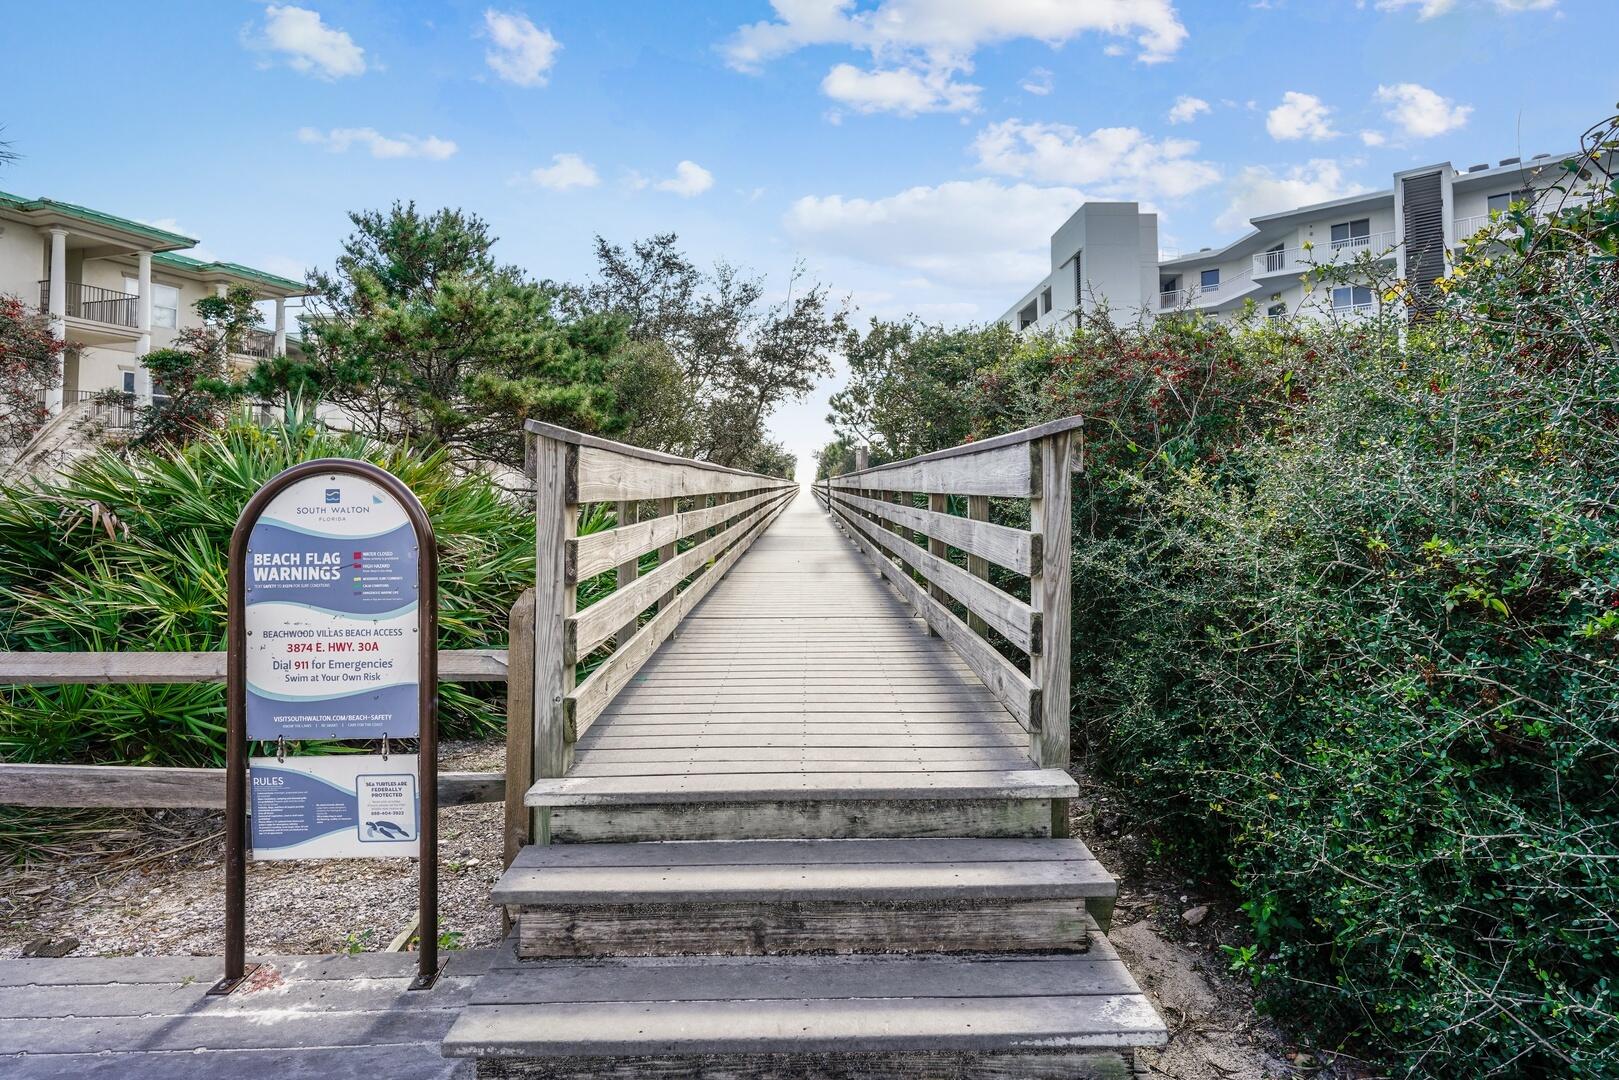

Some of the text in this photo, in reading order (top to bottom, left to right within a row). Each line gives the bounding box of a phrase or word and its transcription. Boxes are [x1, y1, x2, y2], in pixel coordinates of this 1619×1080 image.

[296, 506, 370, 514] SOUTH WALTON
[254, 552, 341, 566] BEACH FLAG
[253, 566, 341, 582] WARNINGS
[287, 642, 379, 652] 3874 E. HWY. 30A
[272, 659, 393, 672] Dial 911 for Emergencies
[285, 674, 308, 682] Swim
[321, 674, 340, 682] Your
[342, 673, 361, 681] Own
[363, 672, 381, 681] Risk
[273, 714, 392, 722] VISITSOUTHWALTON.COM/BEACH-SAFETY
[253, 777, 284, 786] RULES
